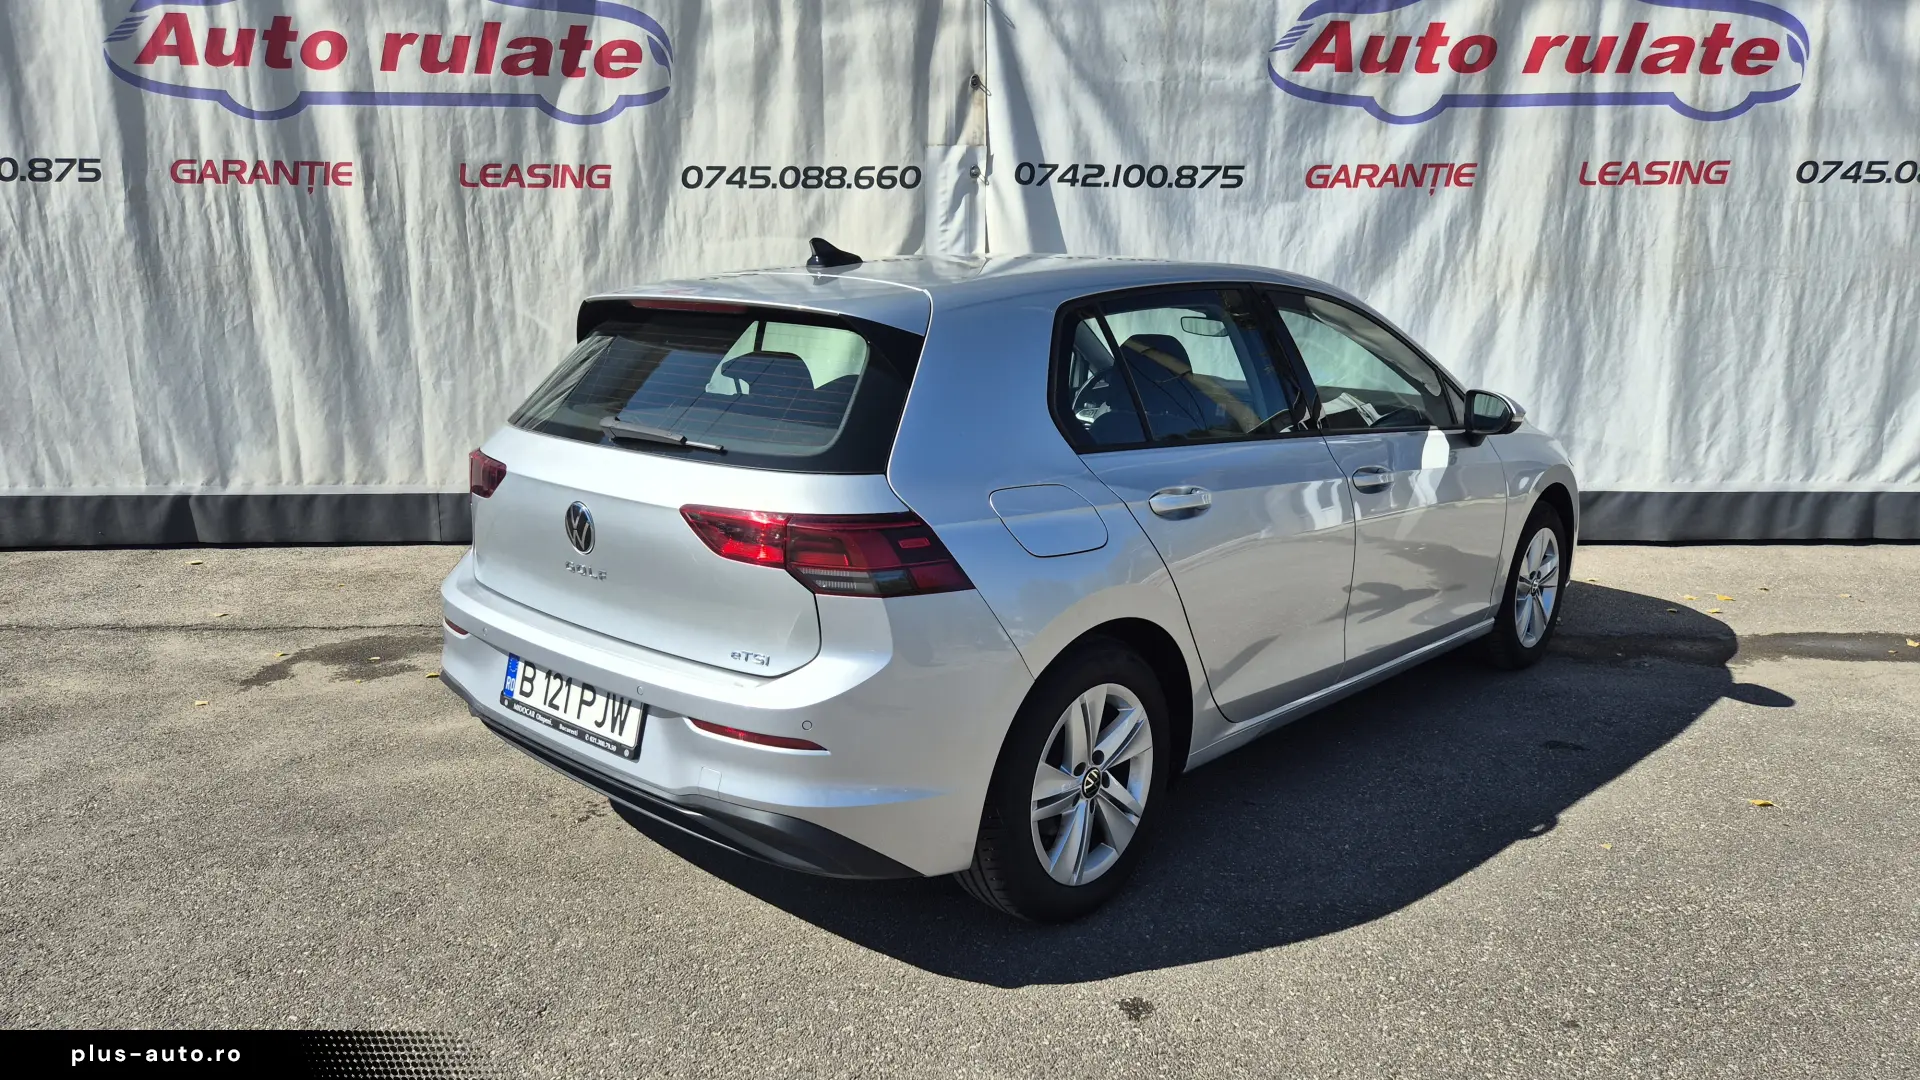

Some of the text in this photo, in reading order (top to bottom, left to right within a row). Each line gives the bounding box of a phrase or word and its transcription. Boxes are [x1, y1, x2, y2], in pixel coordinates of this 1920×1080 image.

[135, 12, 643, 79] Auto rulate
[1292, 20, 1780, 76] Auto rulate
[170, 159, 353, 194] GARANȚIE
[459, 163, 611, 189] LEASING
[681, 165, 922, 190] 0745.088.660
[1014, 161, 1246, 189] 0742.100.875
[1305, 163, 1478, 196] GARANȚIE
[1579, 160, 1731, 186] LEASING
[1796, 160, 1920, 184] 0745.0
[565, 560, 608, 581] GOLF
[730, 650, 771, 667] eTSI
[505, 675, 516, 692] RO
[519, 660, 633, 737] B 121 PJW
